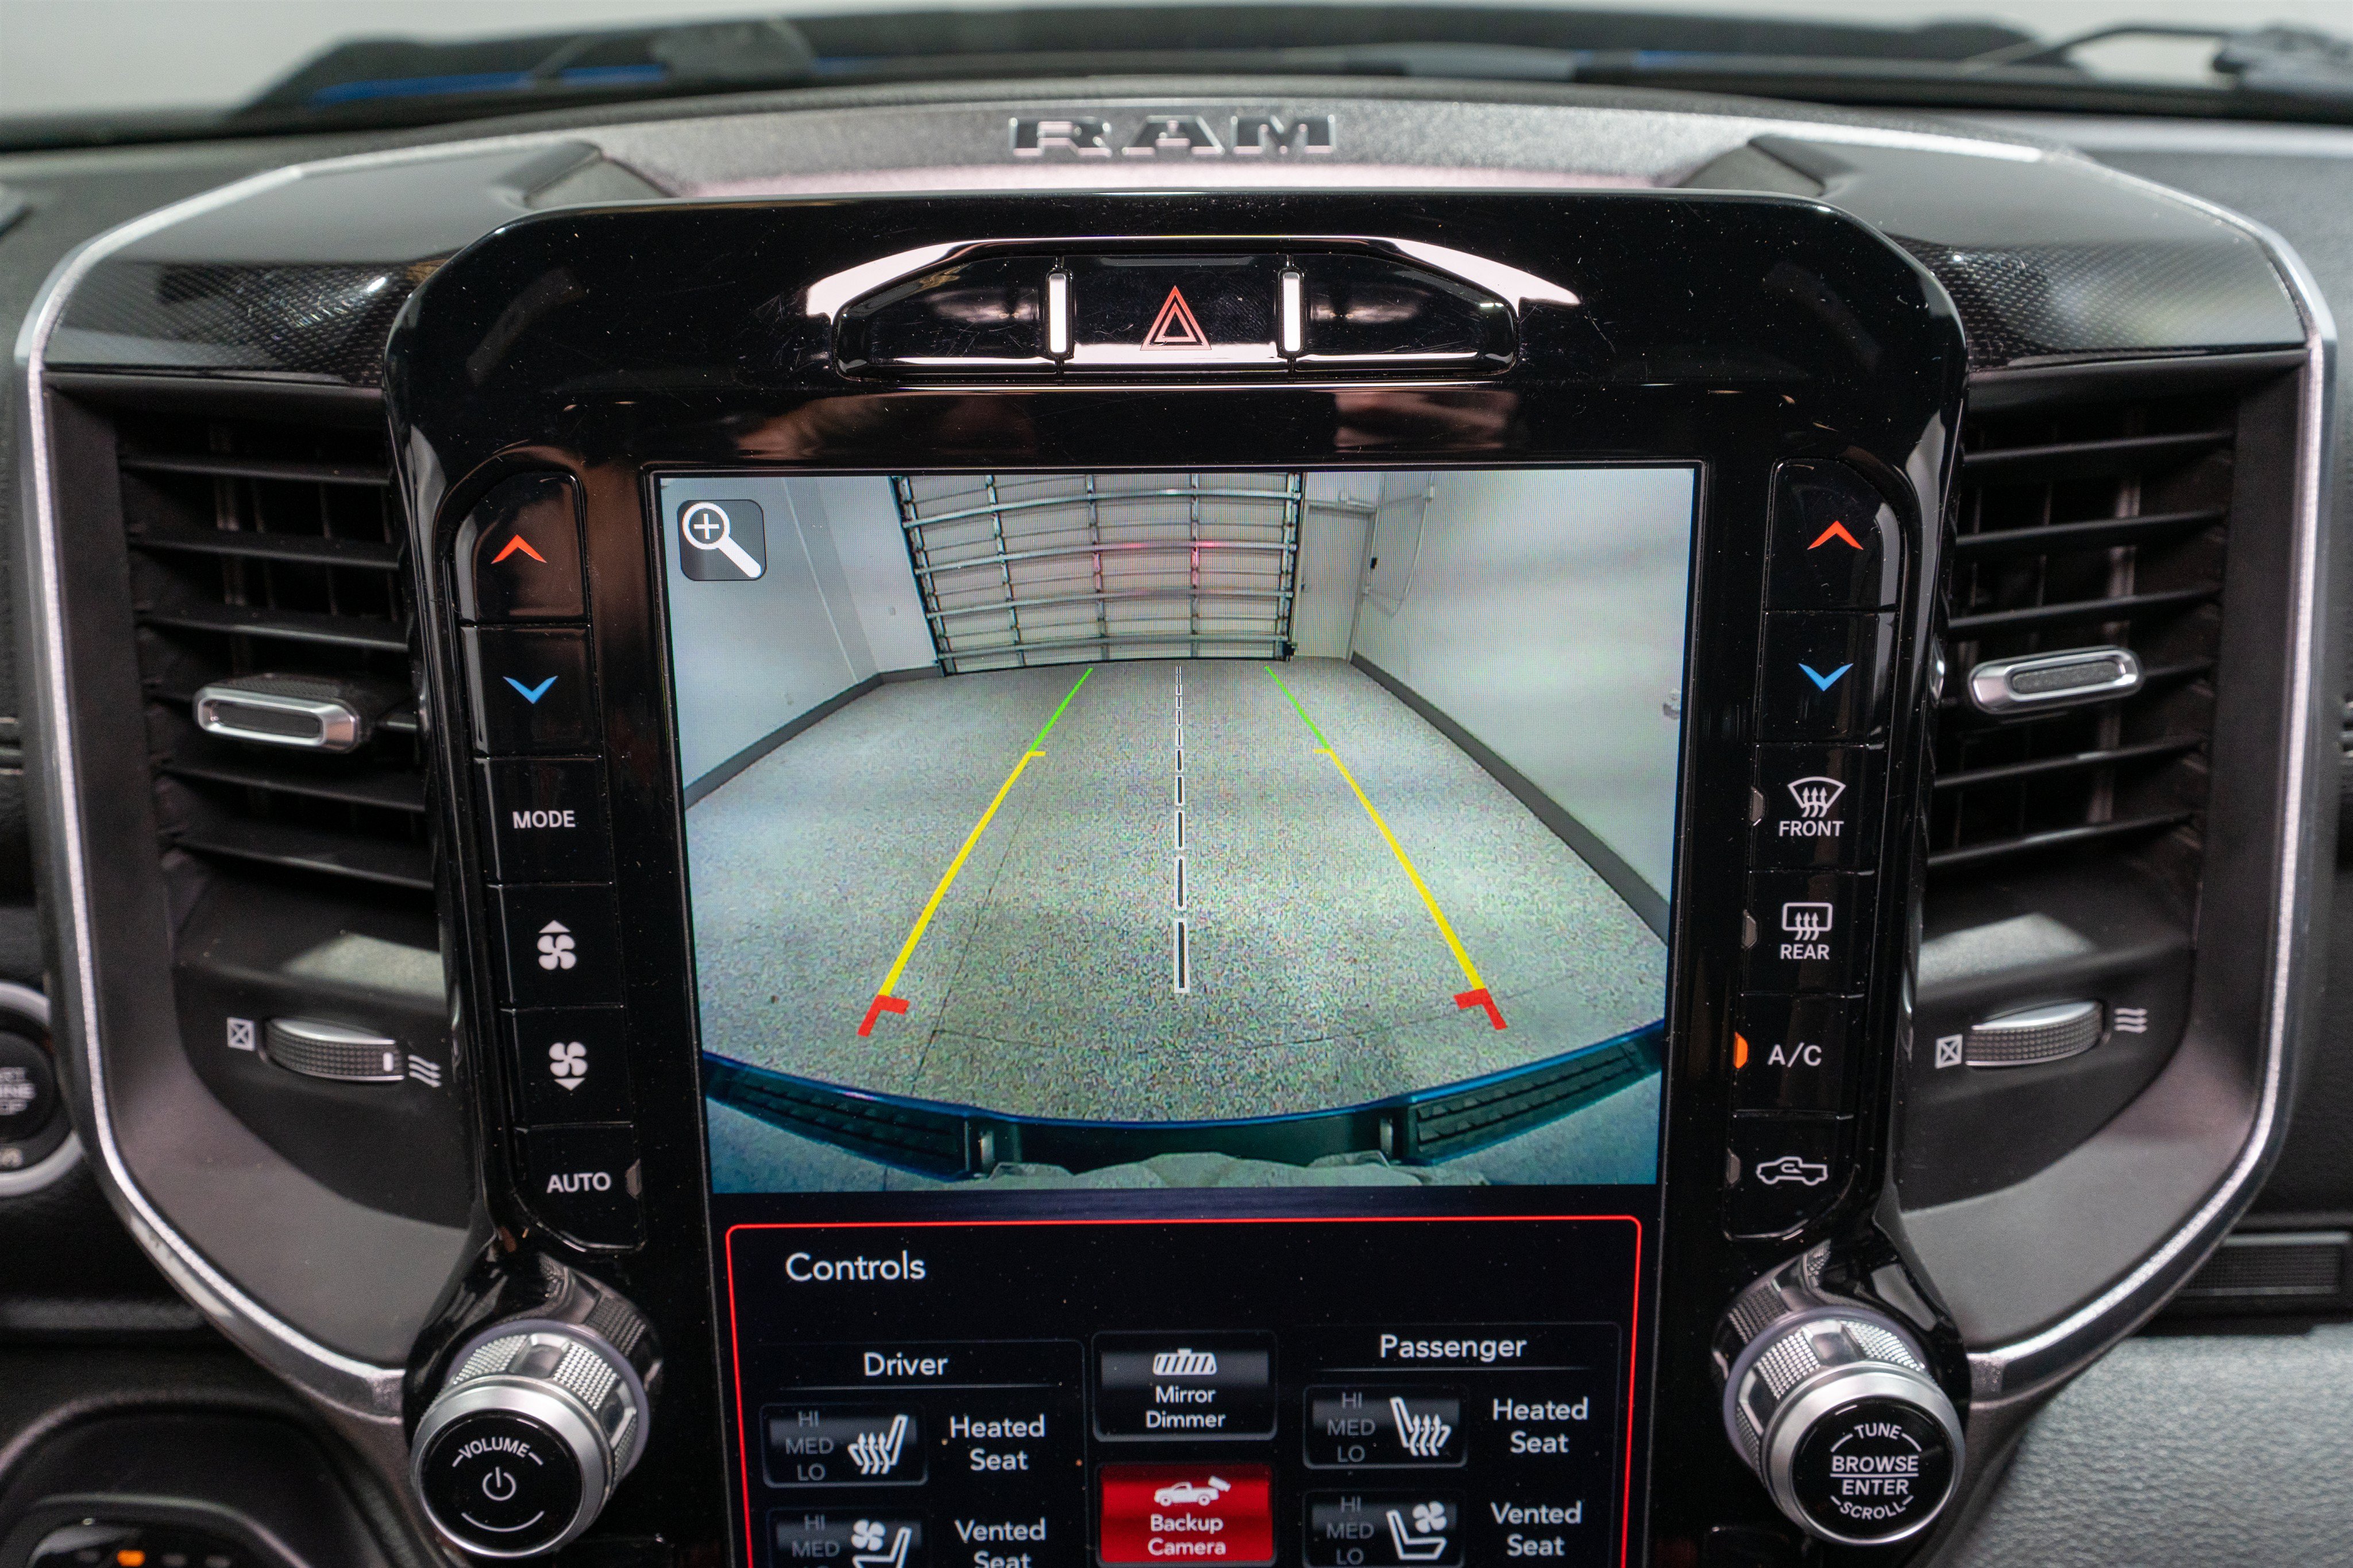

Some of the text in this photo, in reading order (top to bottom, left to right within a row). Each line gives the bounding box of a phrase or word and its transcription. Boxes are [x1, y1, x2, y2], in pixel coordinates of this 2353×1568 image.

[1009, 115, 1337, 157] RAM
[512, 810, 575, 829] MODE
[1779, 820, 1844, 837] FRONT
[1780, 944, 1830, 960] REAR
[1768, 1042, 1822, 1068] A/C
[546, 1172, 611, 1194] AUTO
[785, 1250, 926, 1281] Controls
[1380, 1334, 1527, 1362] Passenger
[863, 1352, 948, 1376] Driver
[1155, 1385, 1216, 1403] Mirror
[1342, 1392, 1362, 1408] HI
[1493, 1396, 1588, 1420] Heated
[799, 1411, 819, 1427] HI
[950, 1413, 1045, 1438] Heated
[1145, 1410, 1226, 1428] Dimmer
[1326, 1418, 1375, 1436] MED
[1854, 1423, 1902, 1439] TUNE
[458, 1437, 530, 1458] VOLUME
[785, 1439, 834, 1454] MED
[1510, 1431, 1569, 1454] Seat
[970, 1448, 1028, 1471] Seat
[1337, 1445, 1365, 1462] LO
[797, 1464, 826, 1481] LO
[1832, 1455, 1919, 1473] BROWSE
[1842, 1478, 1909, 1495] ENTER
[1341, 1496, 1361, 1513] HI
[1491, 1500, 1581, 1524] Vented
[1840, 1501, 1907, 1520] SCROLL
[805, 1515, 825, 1531] HI
[954, 1517, 1046, 1542] Vented
[1150, 1512, 1224, 1534] Backup
[1326, 1521, 1374, 1539] MED
[792, 1540, 840, 1557] MED
[1147, 1538, 1226, 1556] Camera
[1507, 1534, 1564, 1557] Seat
[973, 1551, 1031, 1568] Seat
[1336, 1548, 1364, 1565] LO
